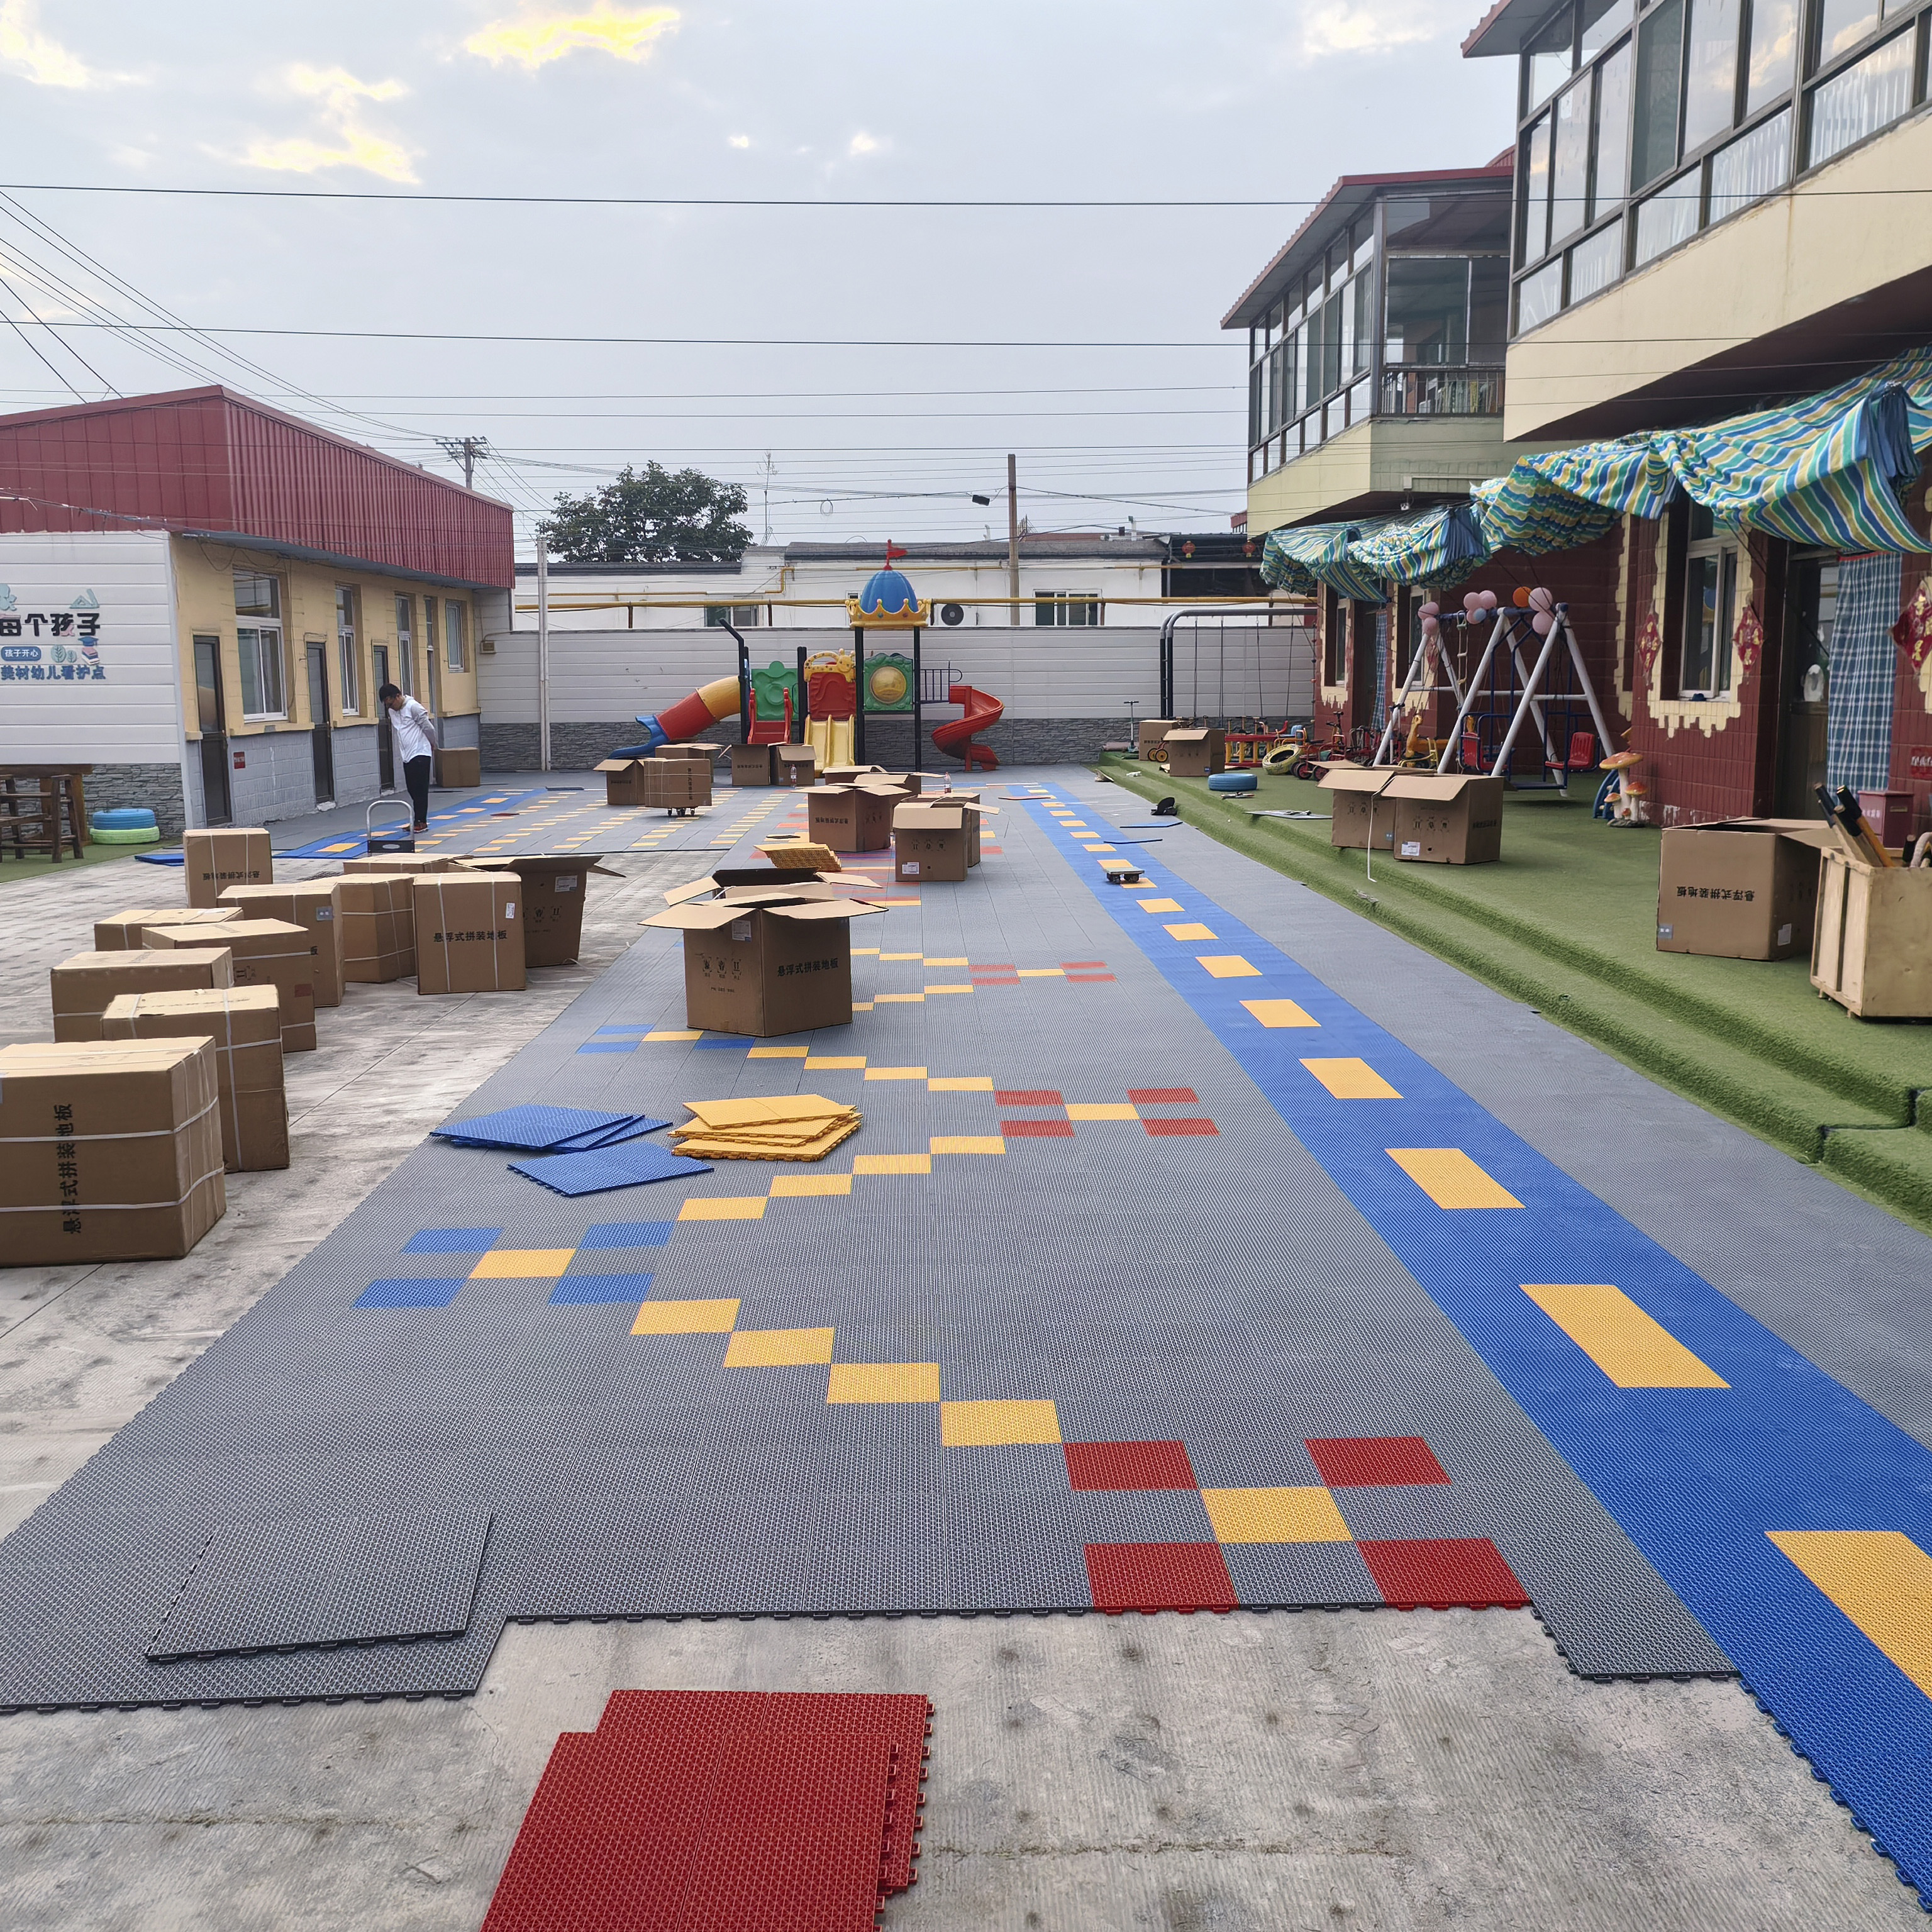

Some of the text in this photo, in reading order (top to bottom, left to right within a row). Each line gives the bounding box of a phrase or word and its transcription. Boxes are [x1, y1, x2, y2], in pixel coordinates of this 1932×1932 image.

[4, 648, 39, 657] 孩子开心
[1676, 886, 1755, 902] 悬浮式拼装地板
[433, 930, 508, 943] 悬浮式拼装地板
[777, 958, 838, 977] 悬浮式拼装地板
[53, 1103, 81, 1234] 悬浮式拼装地板
